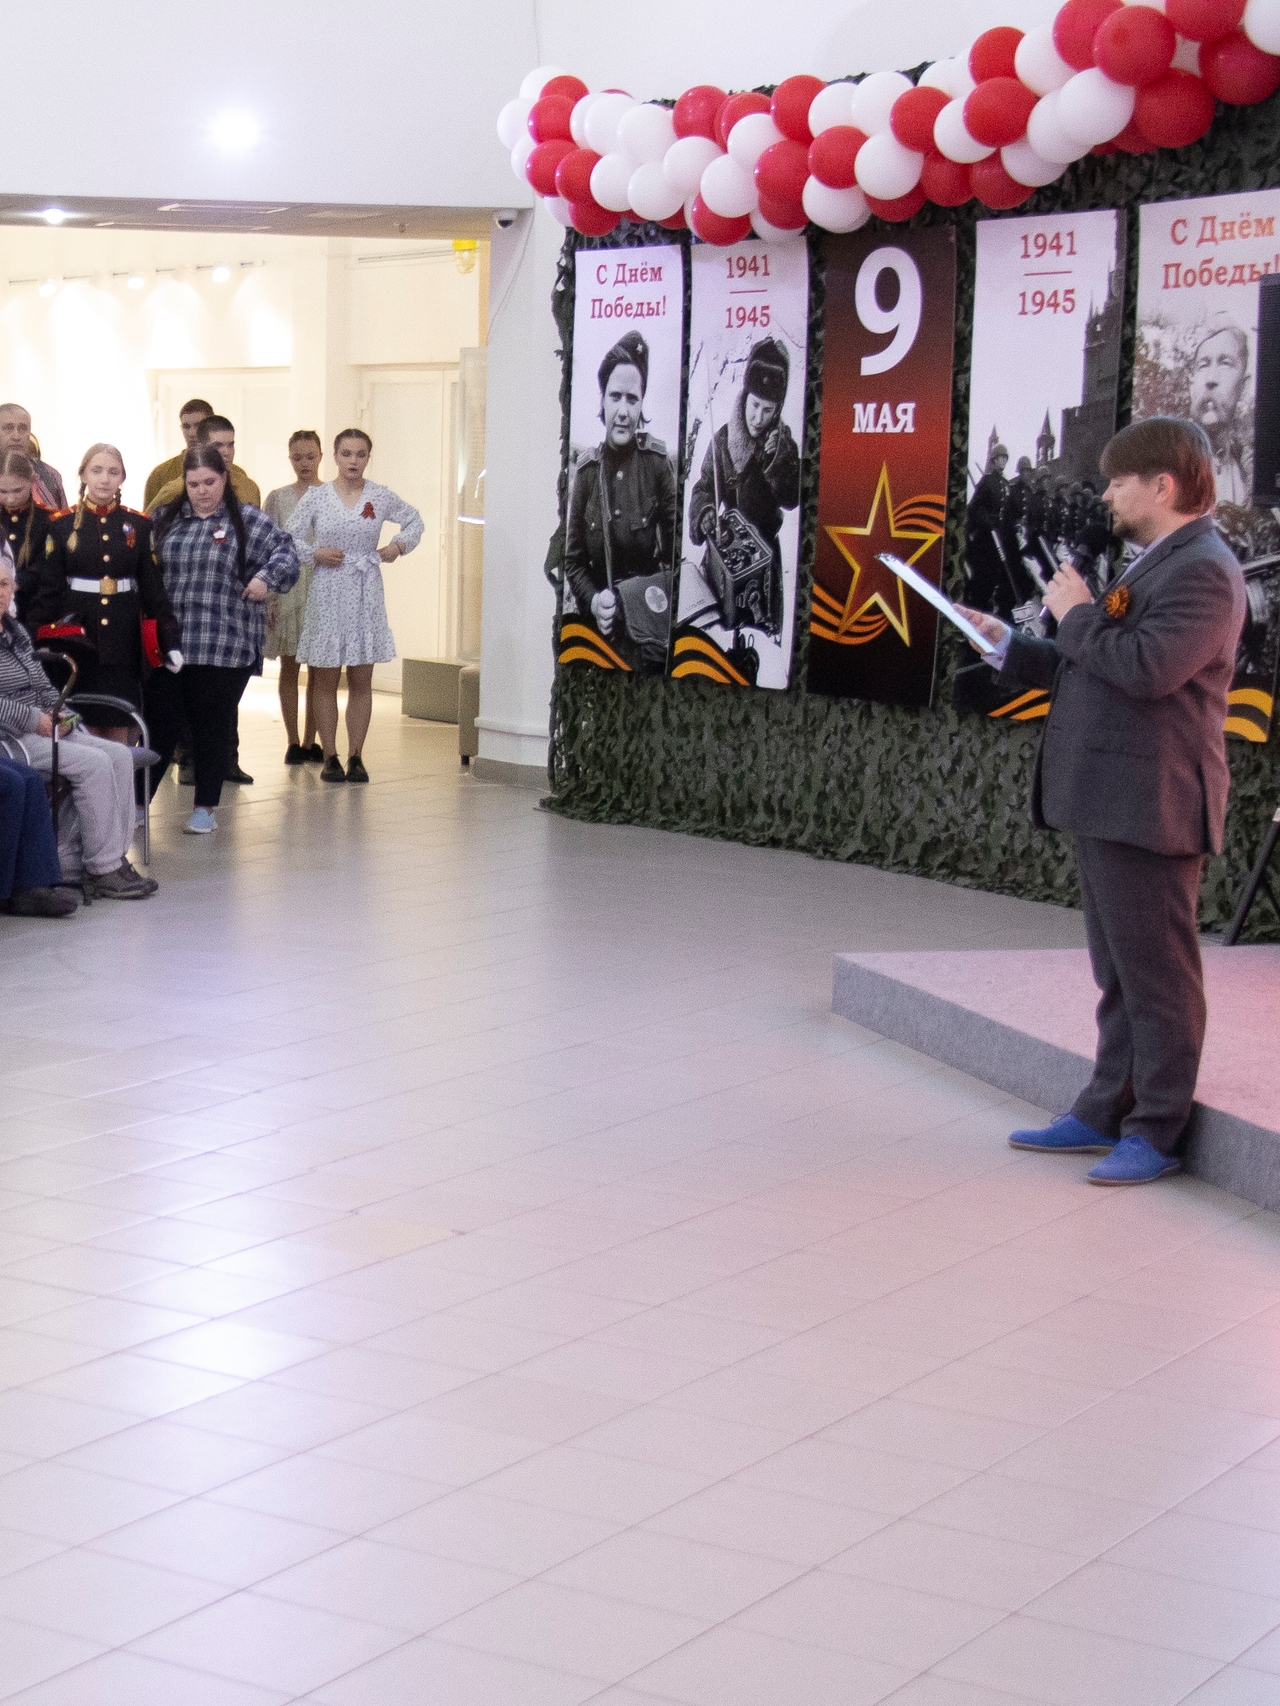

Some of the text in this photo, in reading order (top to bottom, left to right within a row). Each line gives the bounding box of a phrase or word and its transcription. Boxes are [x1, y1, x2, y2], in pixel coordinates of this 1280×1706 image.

[1170, 211, 1275, 248] С Днём
[1020, 230, 1077, 259] 1941
[596, 261, 663, 287] С Днём
[726, 254, 770, 279] 1941
[589, 295, 667, 319] Победы!
[854, 246, 923, 376] 9
[1017, 288, 1076, 316] 1945
[725, 305, 771, 329] 1945
[852, 402, 916, 434] МАЯ
